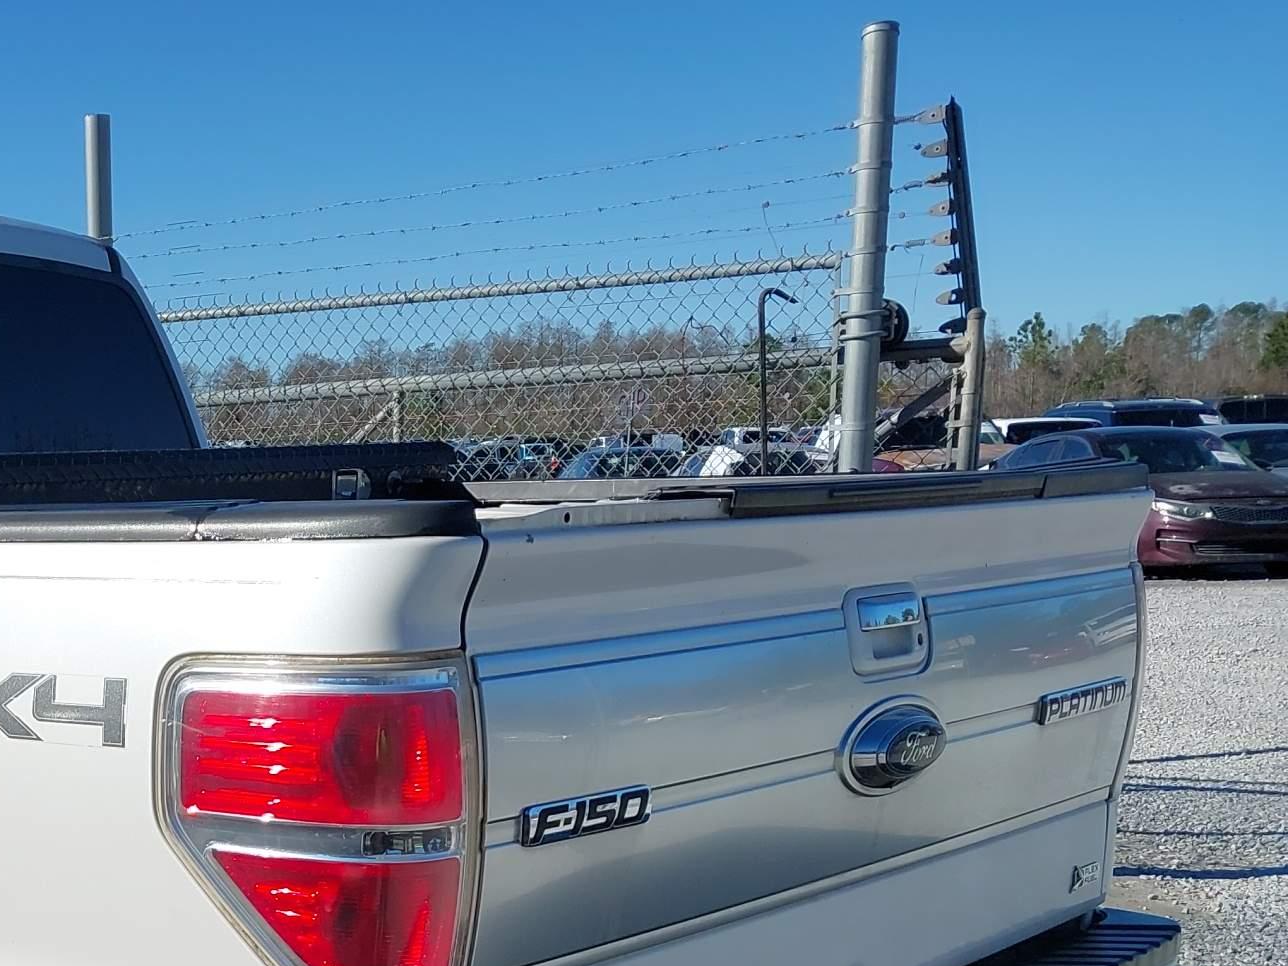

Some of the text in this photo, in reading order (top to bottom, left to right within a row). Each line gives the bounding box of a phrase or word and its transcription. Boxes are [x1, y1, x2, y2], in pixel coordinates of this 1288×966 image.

[1046, 679, 1128, 722] PLATINUM
[900, 730, 938, 766] Ford
[529, 787, 651, 846] F-150
